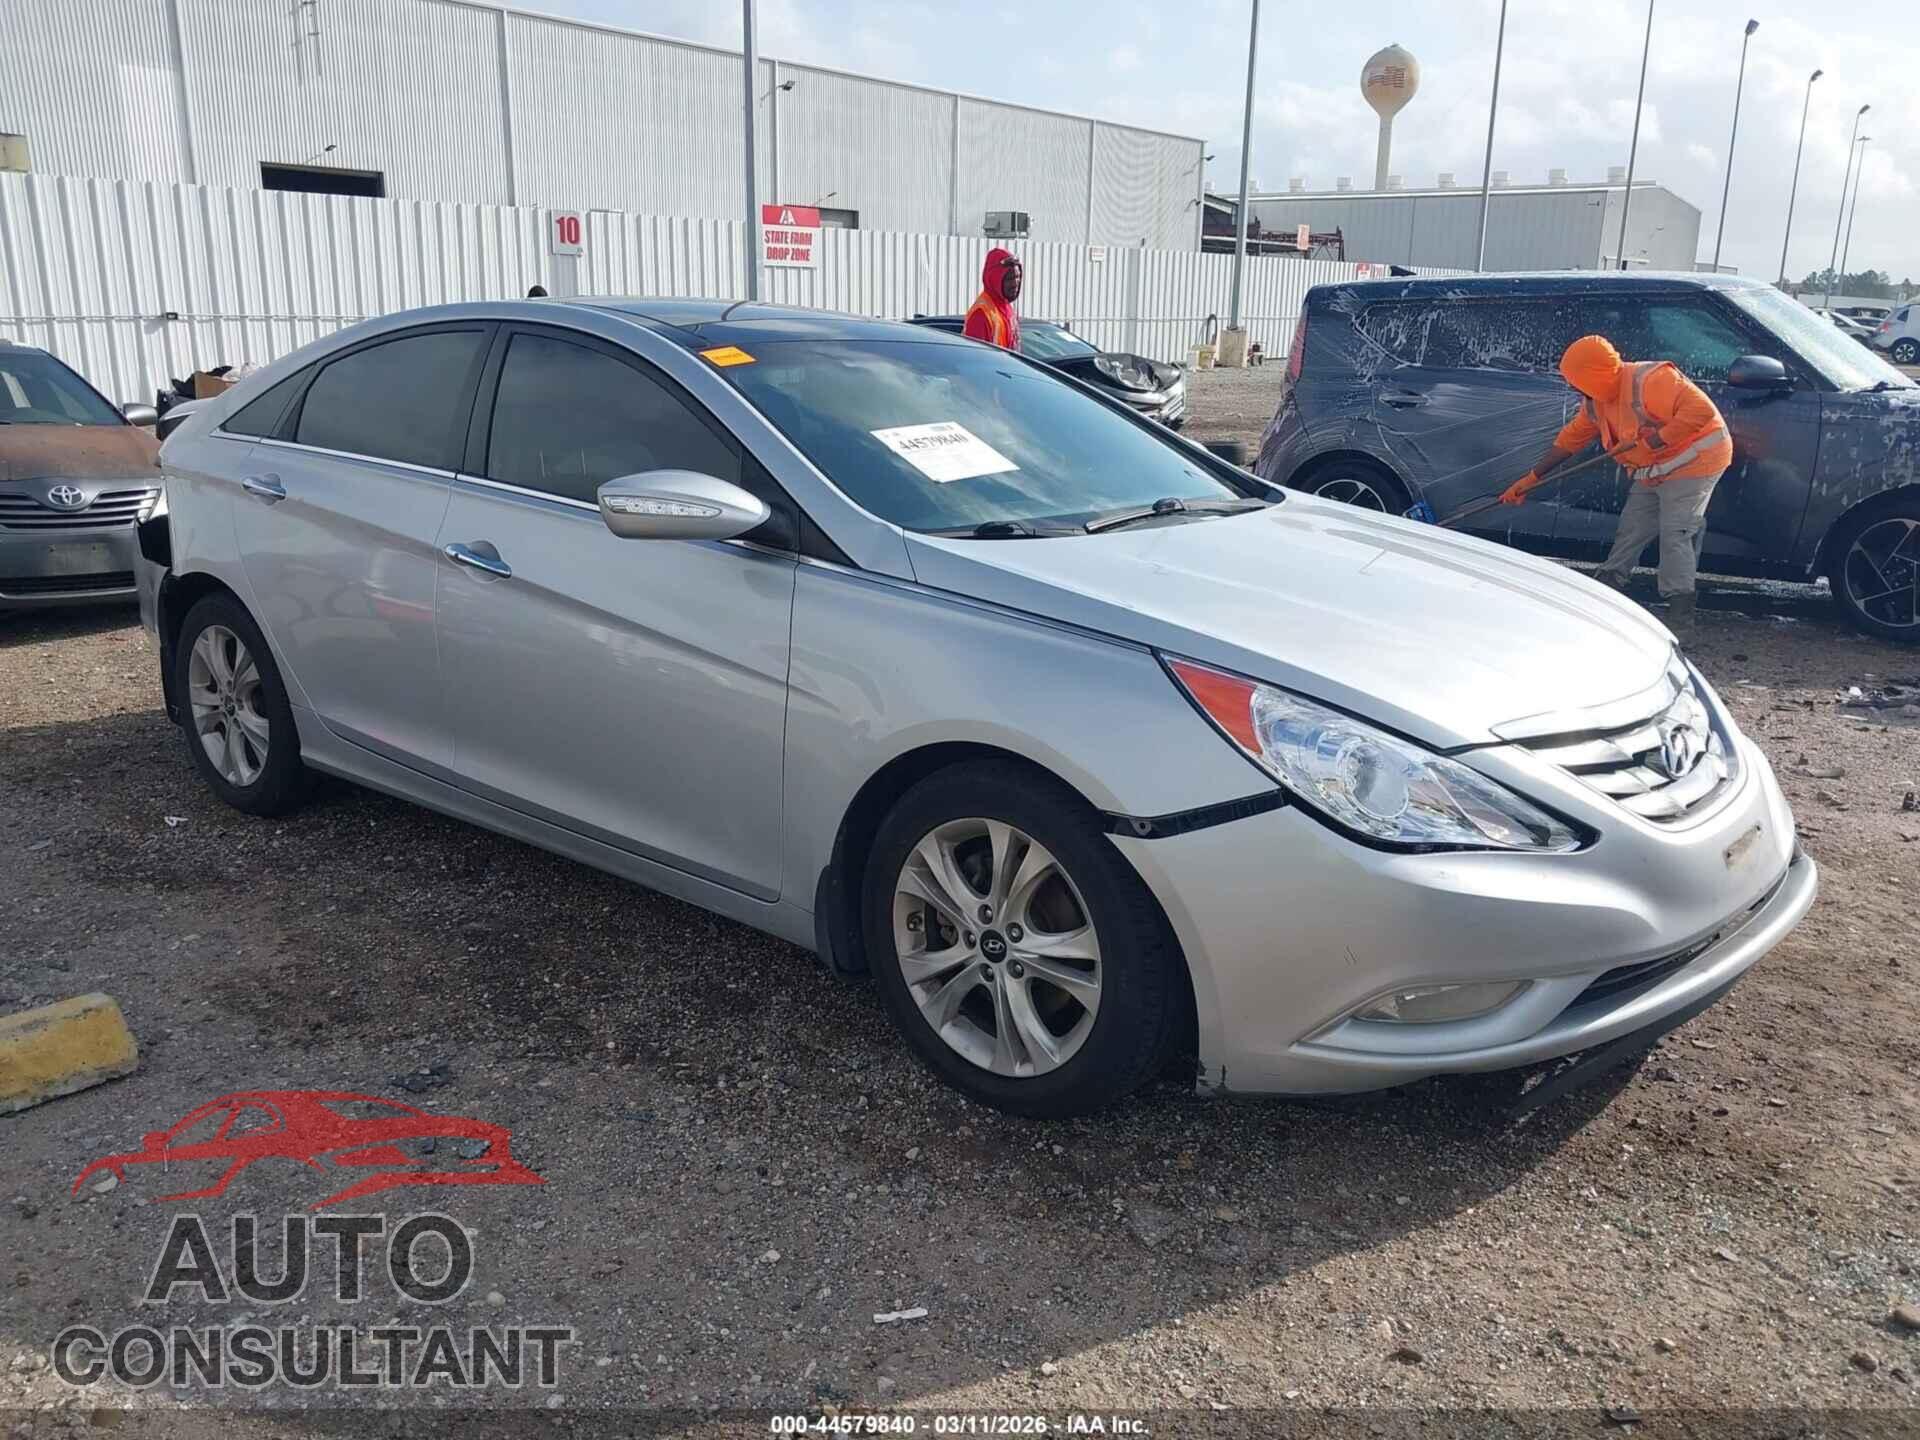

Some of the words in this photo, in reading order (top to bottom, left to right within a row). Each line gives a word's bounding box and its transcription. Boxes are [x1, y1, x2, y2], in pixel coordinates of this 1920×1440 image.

[555, 216, 580, 245] 10
[764, 230, 789, 244] STATE
[766, 246, 790, 261] DROP
[790, 247, 811, 262] ZONE
